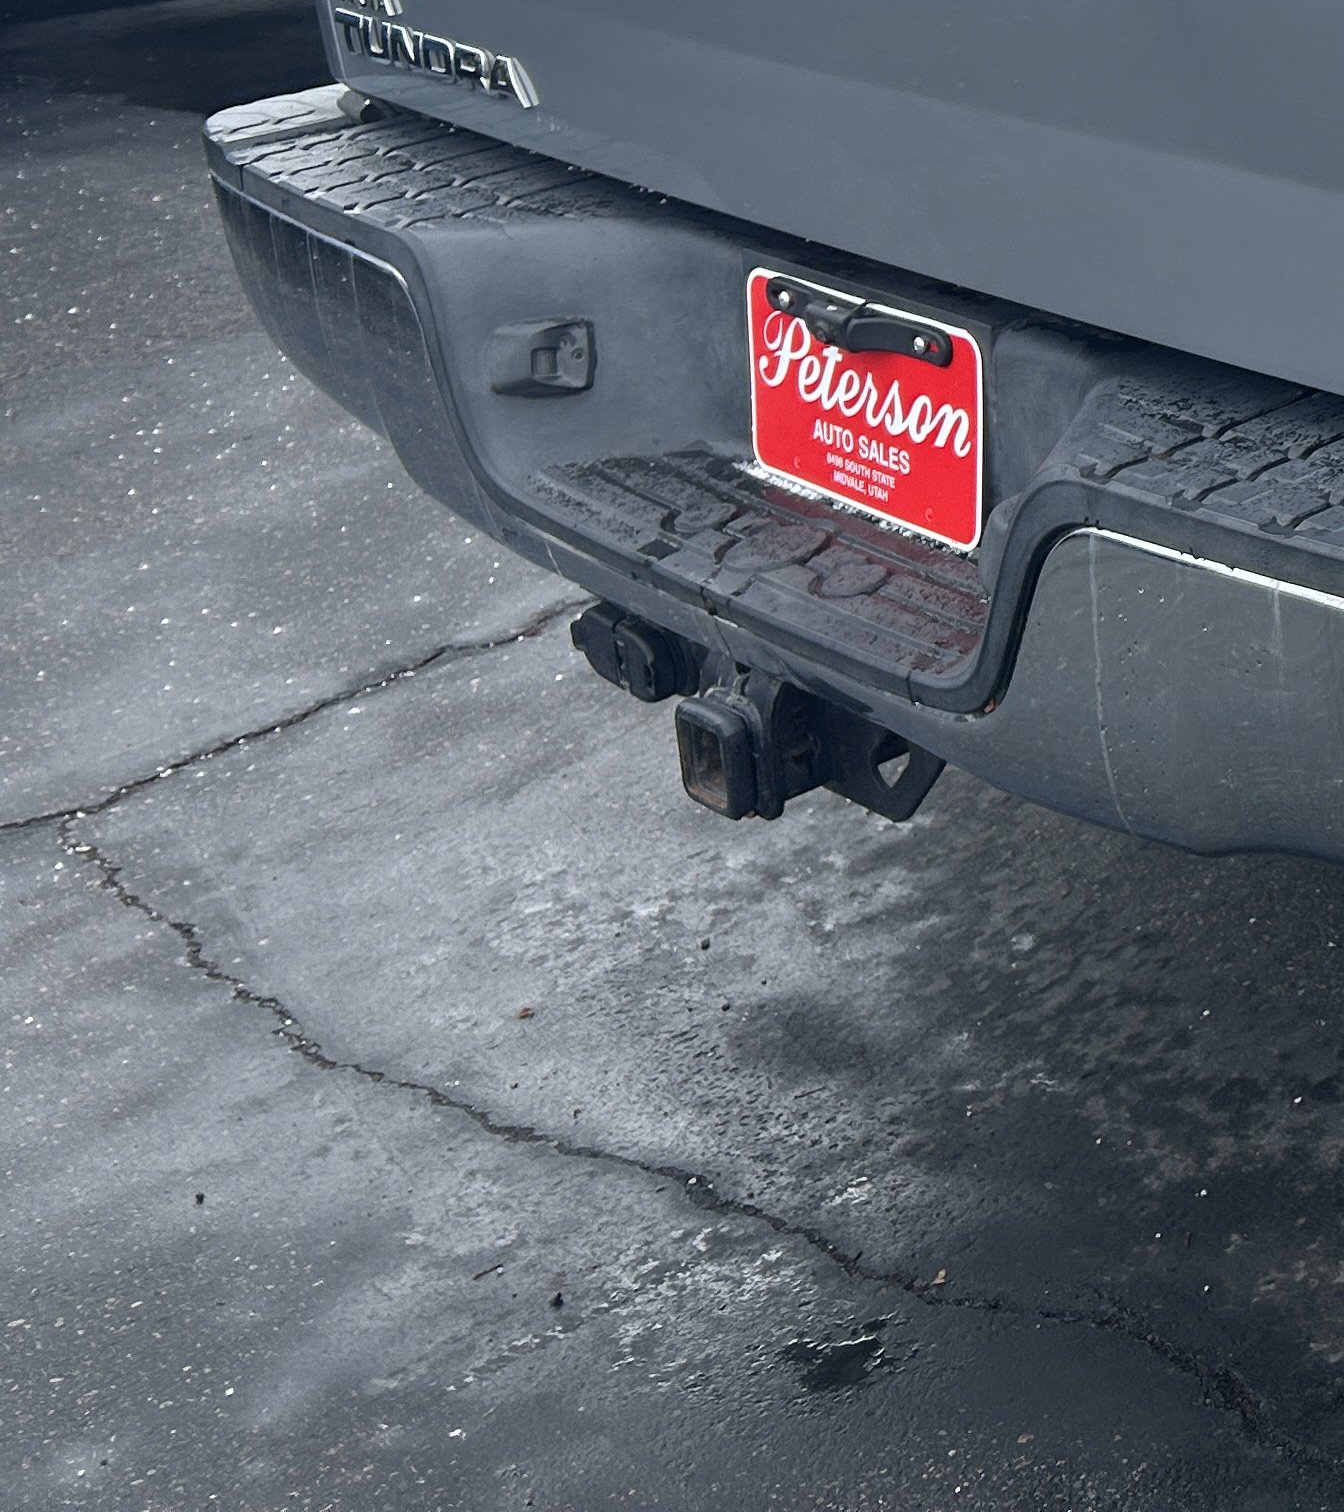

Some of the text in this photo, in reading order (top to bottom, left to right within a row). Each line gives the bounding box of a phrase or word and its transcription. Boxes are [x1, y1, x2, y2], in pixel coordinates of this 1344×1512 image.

[334, 7, 540, 109] TUNDRA
[759, 310, 971, 457] Peterson
[813, 418, 911, 475] AUTO SALES
[844, 458, 871, 479] SOUTH
[871, 469, 896, 489] STATE
[868, 484, 889, 502] UTAH
